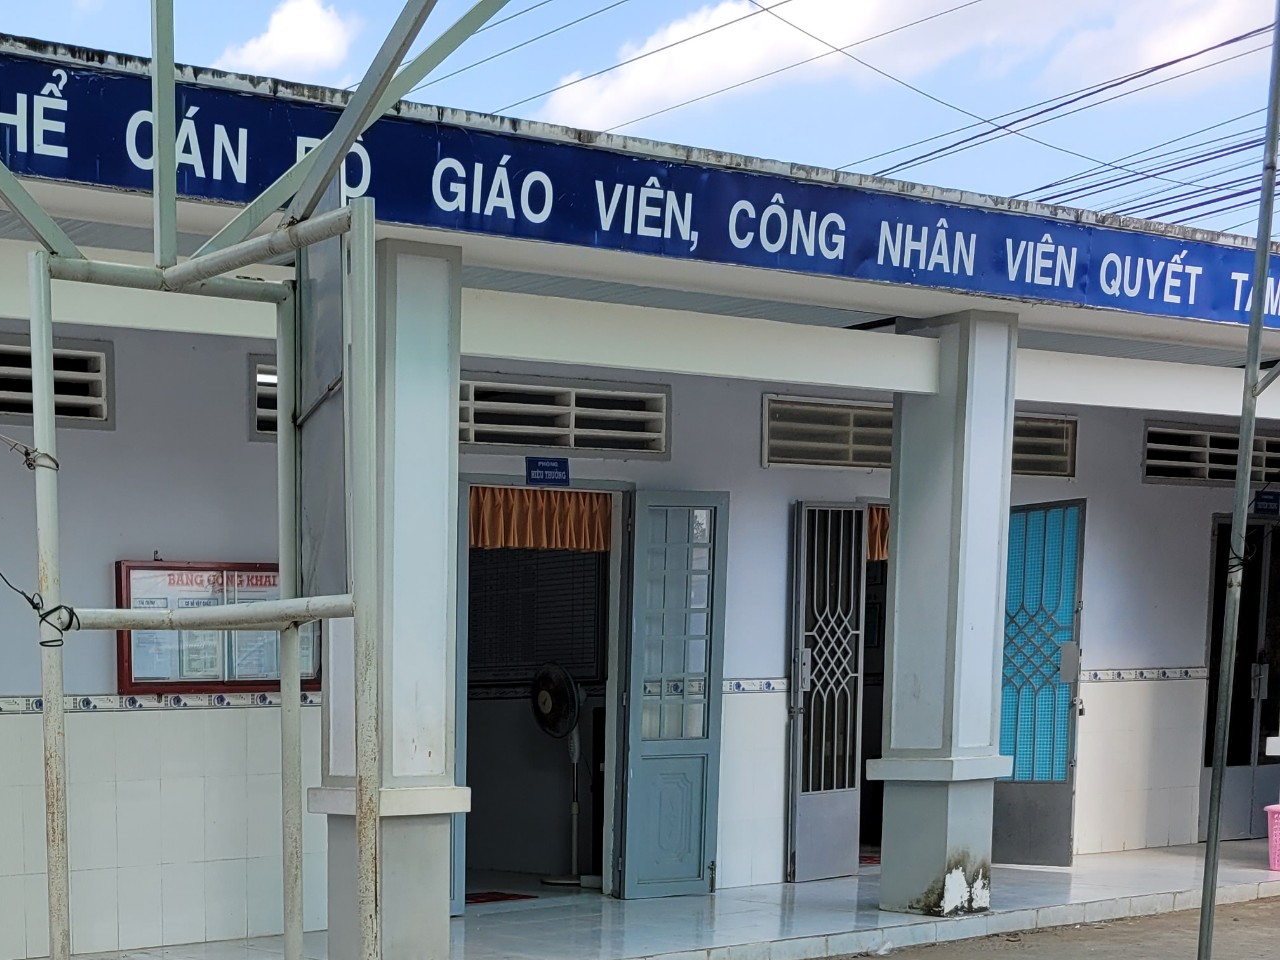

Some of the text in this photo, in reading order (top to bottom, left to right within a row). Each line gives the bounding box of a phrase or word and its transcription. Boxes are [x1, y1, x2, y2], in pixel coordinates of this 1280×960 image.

[126, 106, 248, 184] CÁN
[432, 154, 554, 224] GIÁO
[595, 176, 698, 252] VIÊN,
[728, 193, 847, 260] CÔNG
[877, 218, 977, 276] NHÂN
[1006, 233, 1078, 288] VIÊN
[1100, 250, 1203, 305] QUYẾT
[1231, 271, 1280, 317] TM
[247, 574, 278, 588] KHAI
